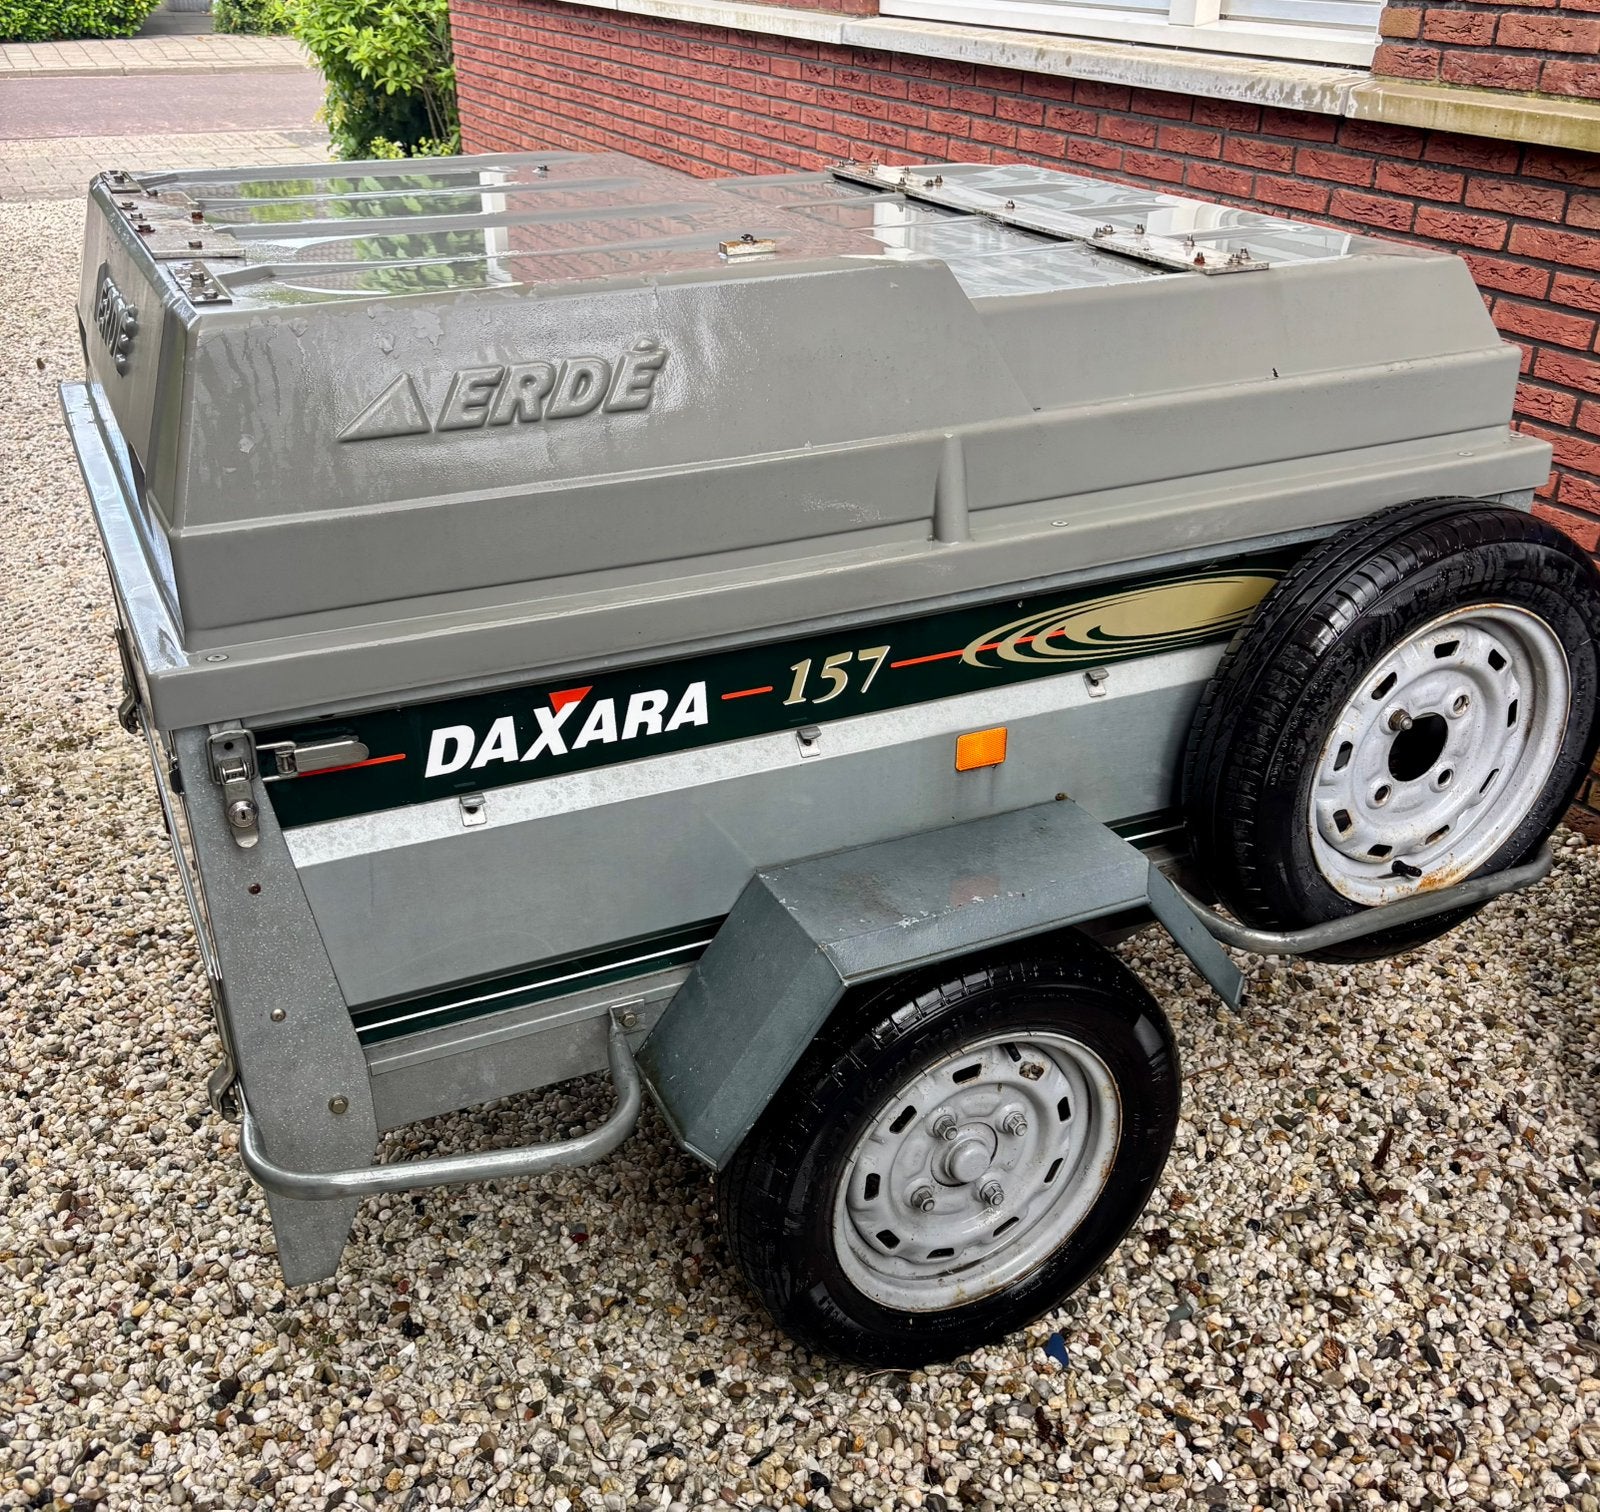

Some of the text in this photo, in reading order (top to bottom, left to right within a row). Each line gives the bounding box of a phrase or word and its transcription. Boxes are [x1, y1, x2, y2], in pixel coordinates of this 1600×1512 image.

[435, 336, 670, 433] ERDÉ
[424, 645, 891, 778] DAXARA 157
